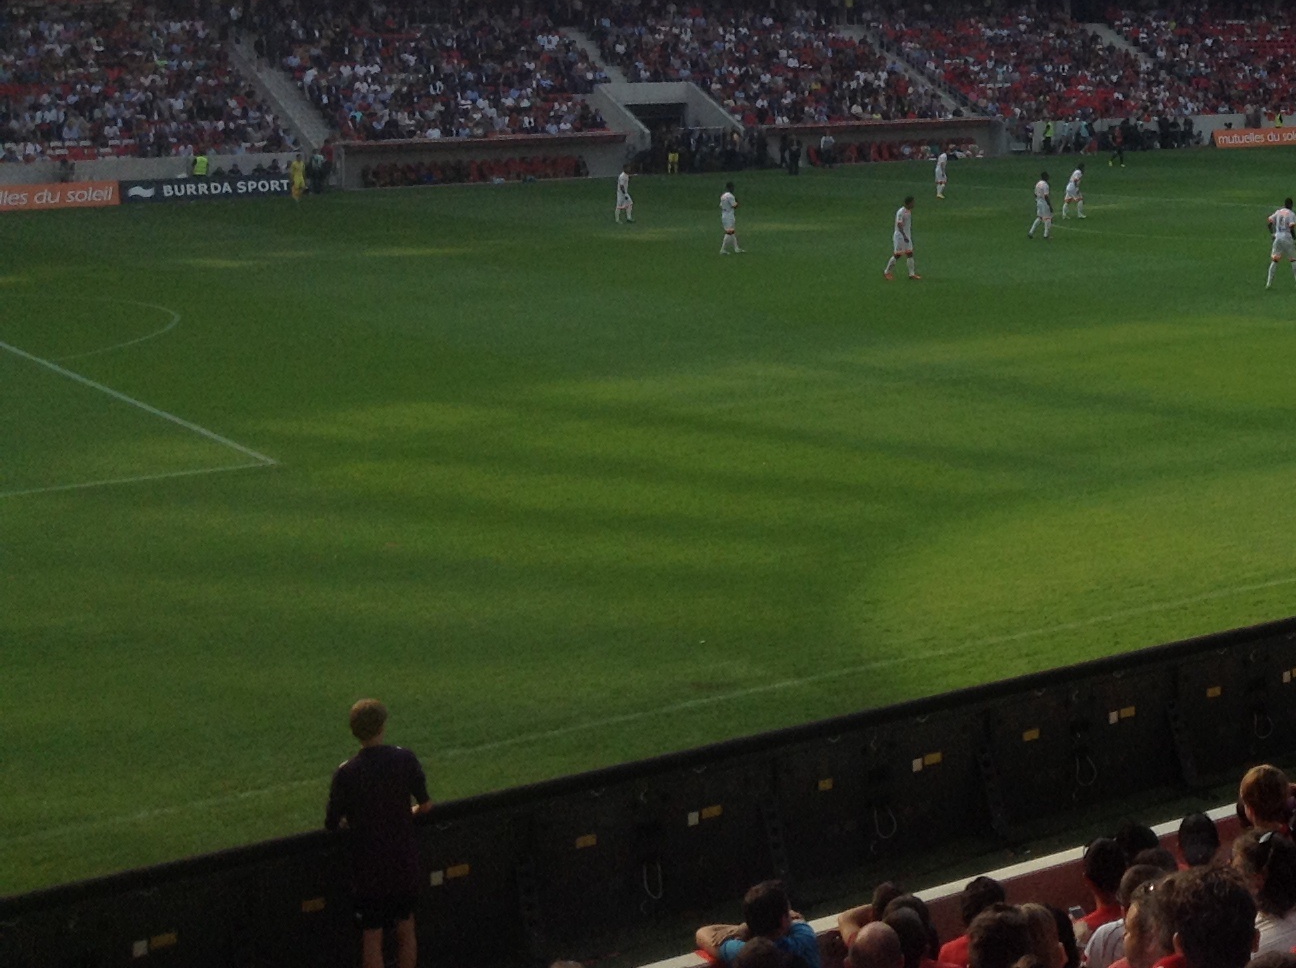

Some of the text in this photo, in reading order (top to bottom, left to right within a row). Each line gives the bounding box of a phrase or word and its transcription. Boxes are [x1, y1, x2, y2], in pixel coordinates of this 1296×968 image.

[1218, 133, 1265, 145] mutuelles
[1267, 132, 1281, 143] du
[34, 189, 61, 204] du
[66, 186, 113, 202] soleil
[162, 179, 290, 198] BURRDA SPORT
